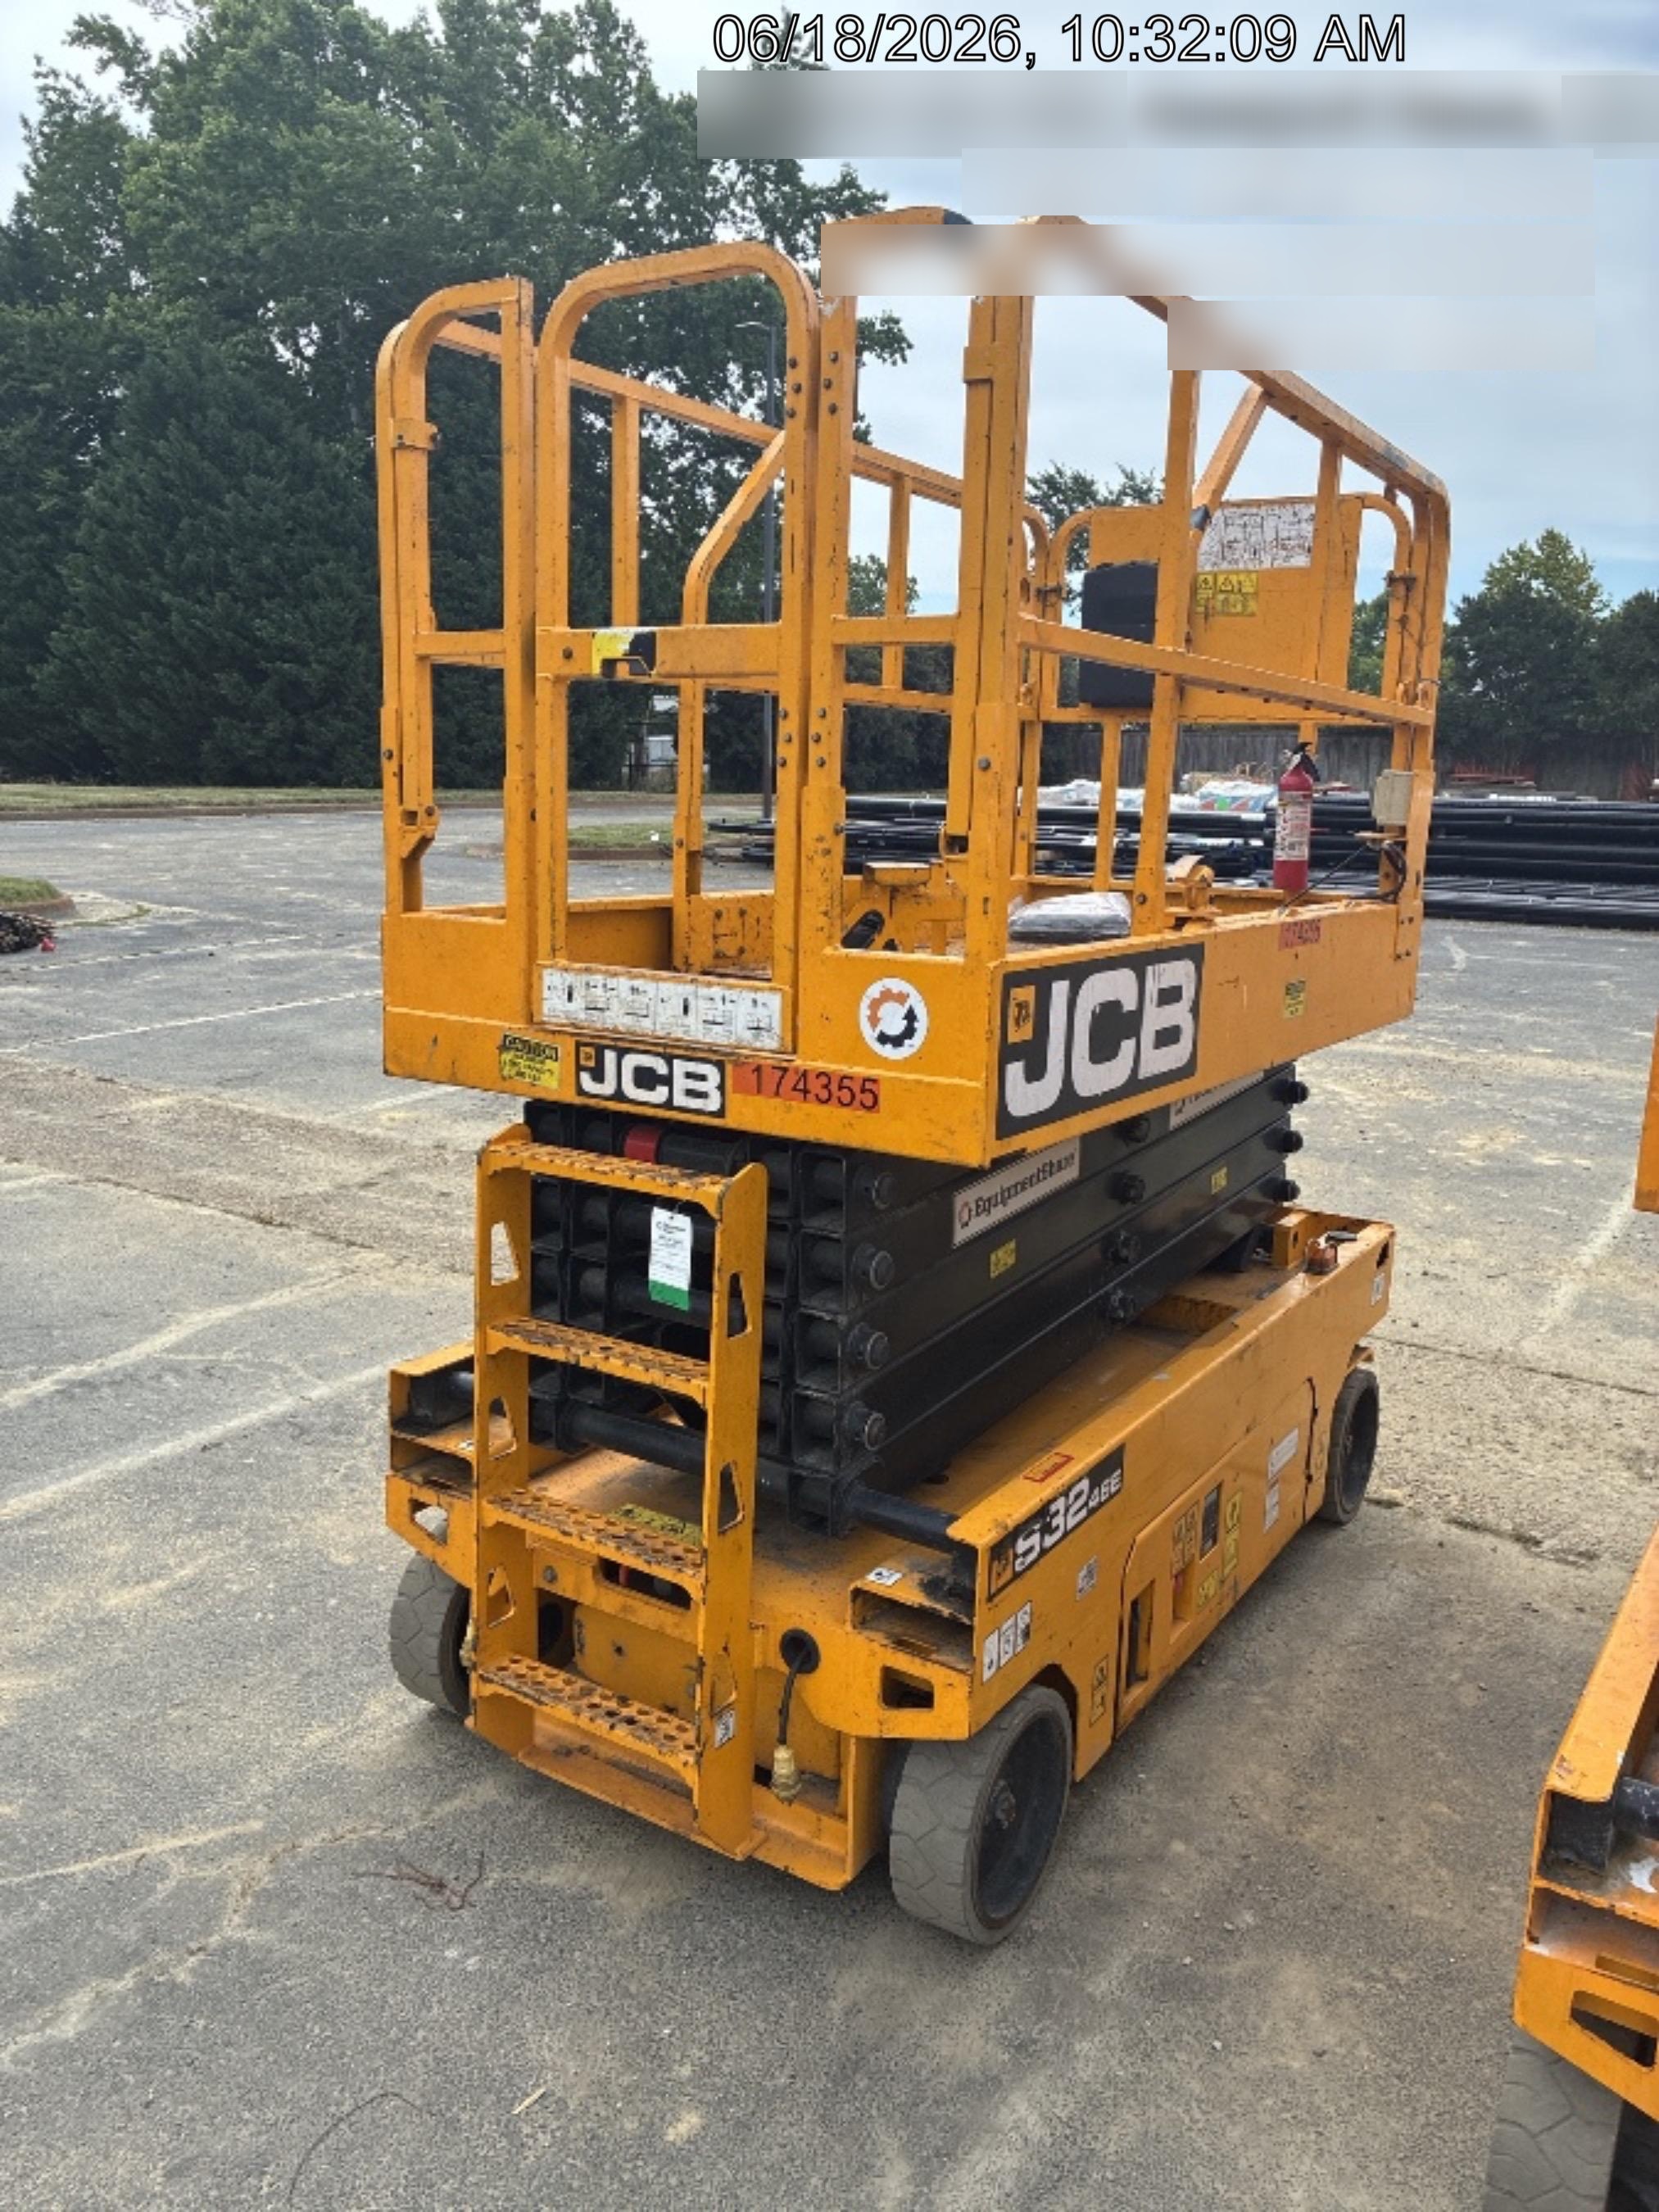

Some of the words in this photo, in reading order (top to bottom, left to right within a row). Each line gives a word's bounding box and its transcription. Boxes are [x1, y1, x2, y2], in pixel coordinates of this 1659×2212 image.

[1004, 959, 1197, 1117] JCB
[579, 1048, 723, 1113] JCB
[751, 1064, 881, 1110] 174355
